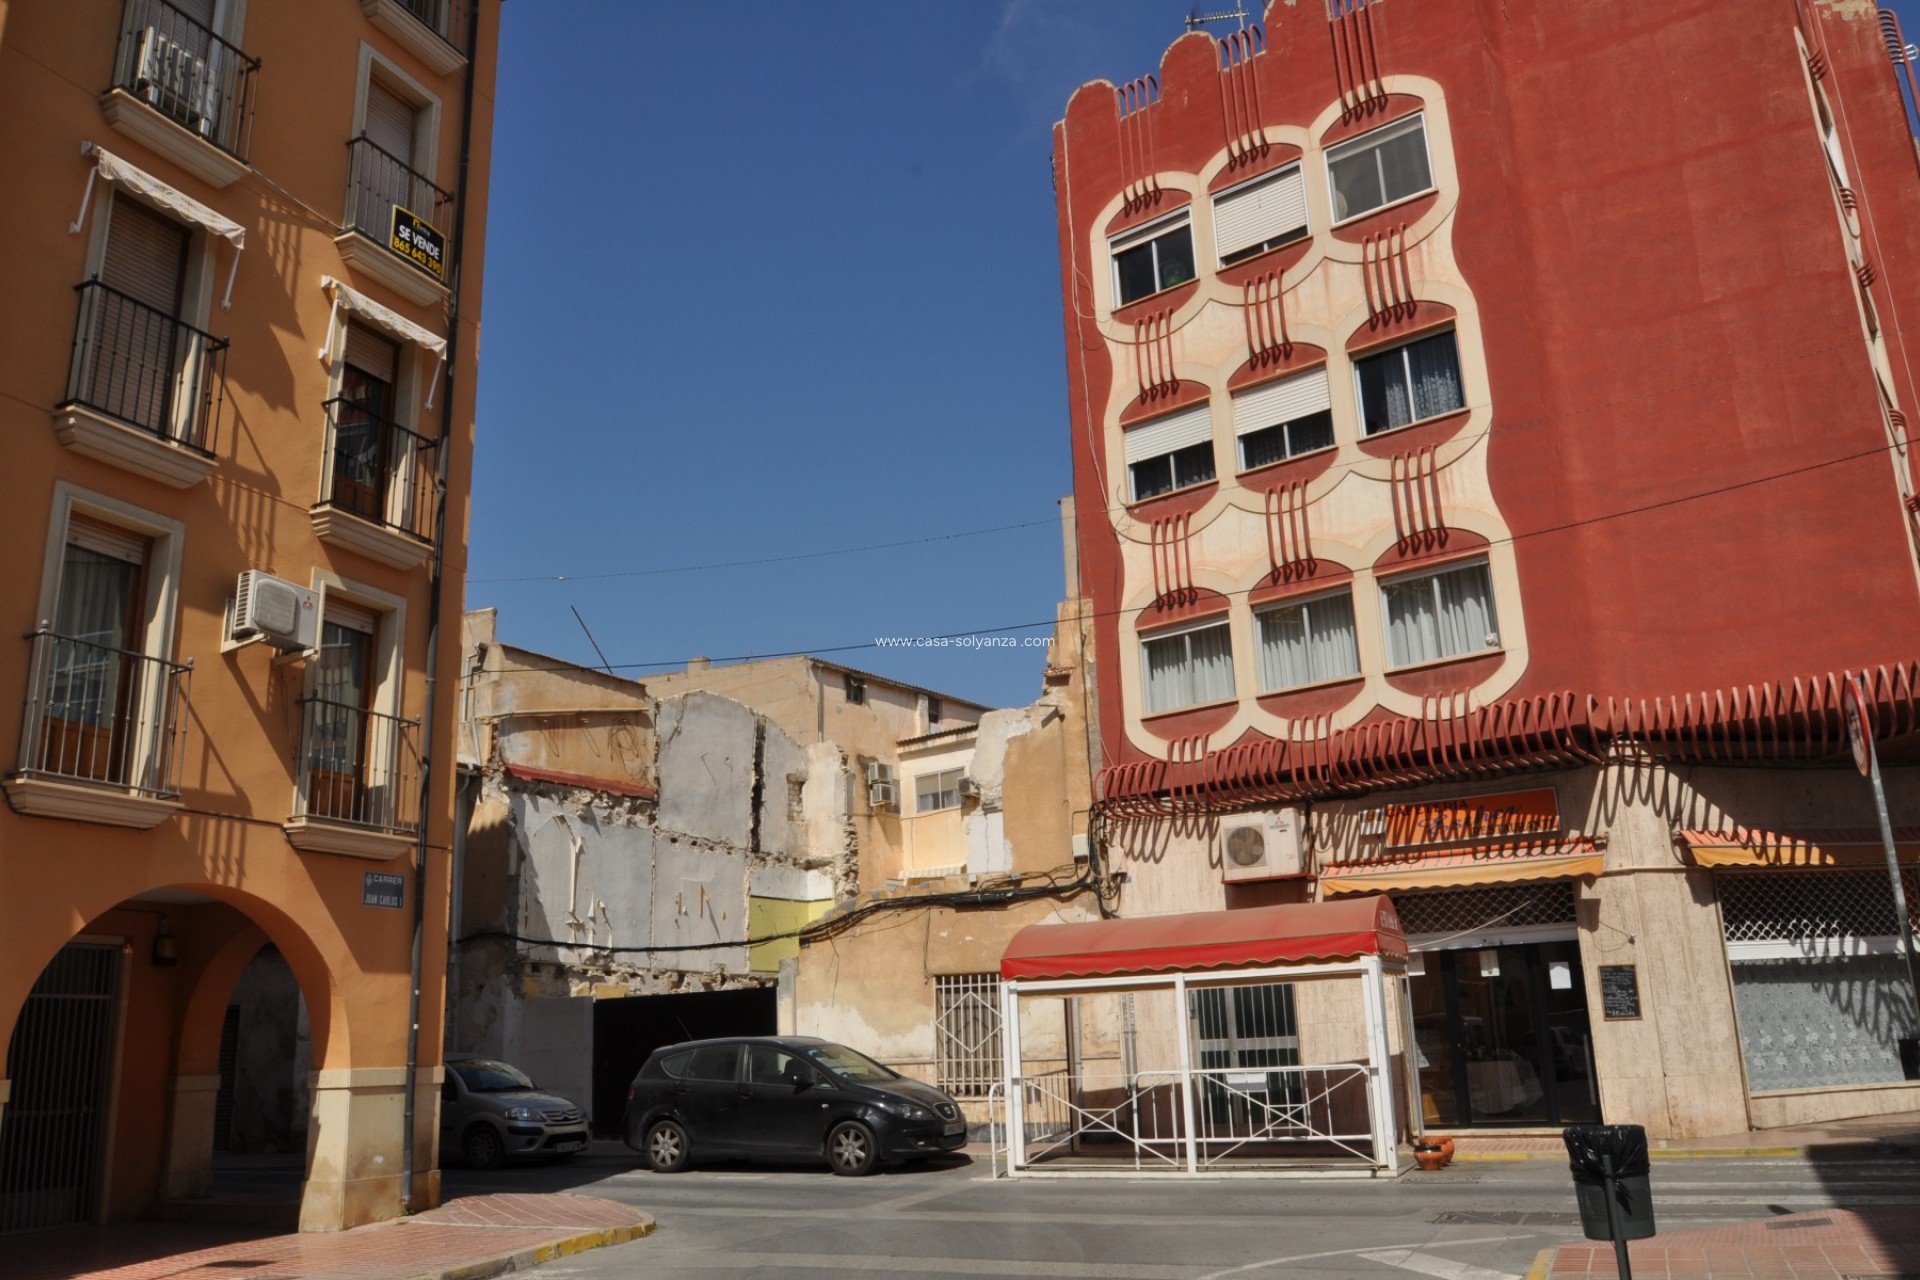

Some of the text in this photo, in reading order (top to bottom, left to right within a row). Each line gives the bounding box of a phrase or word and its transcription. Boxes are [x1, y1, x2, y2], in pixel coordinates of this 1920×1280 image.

[393, 237, 411, 254] 865
[398, 224, 412, 242] SE
[412, 231, 441, 260] VENDE
[1386, 799, 1469, 818] CAFETERIA
[373, 874, 403, 885] CARRER
